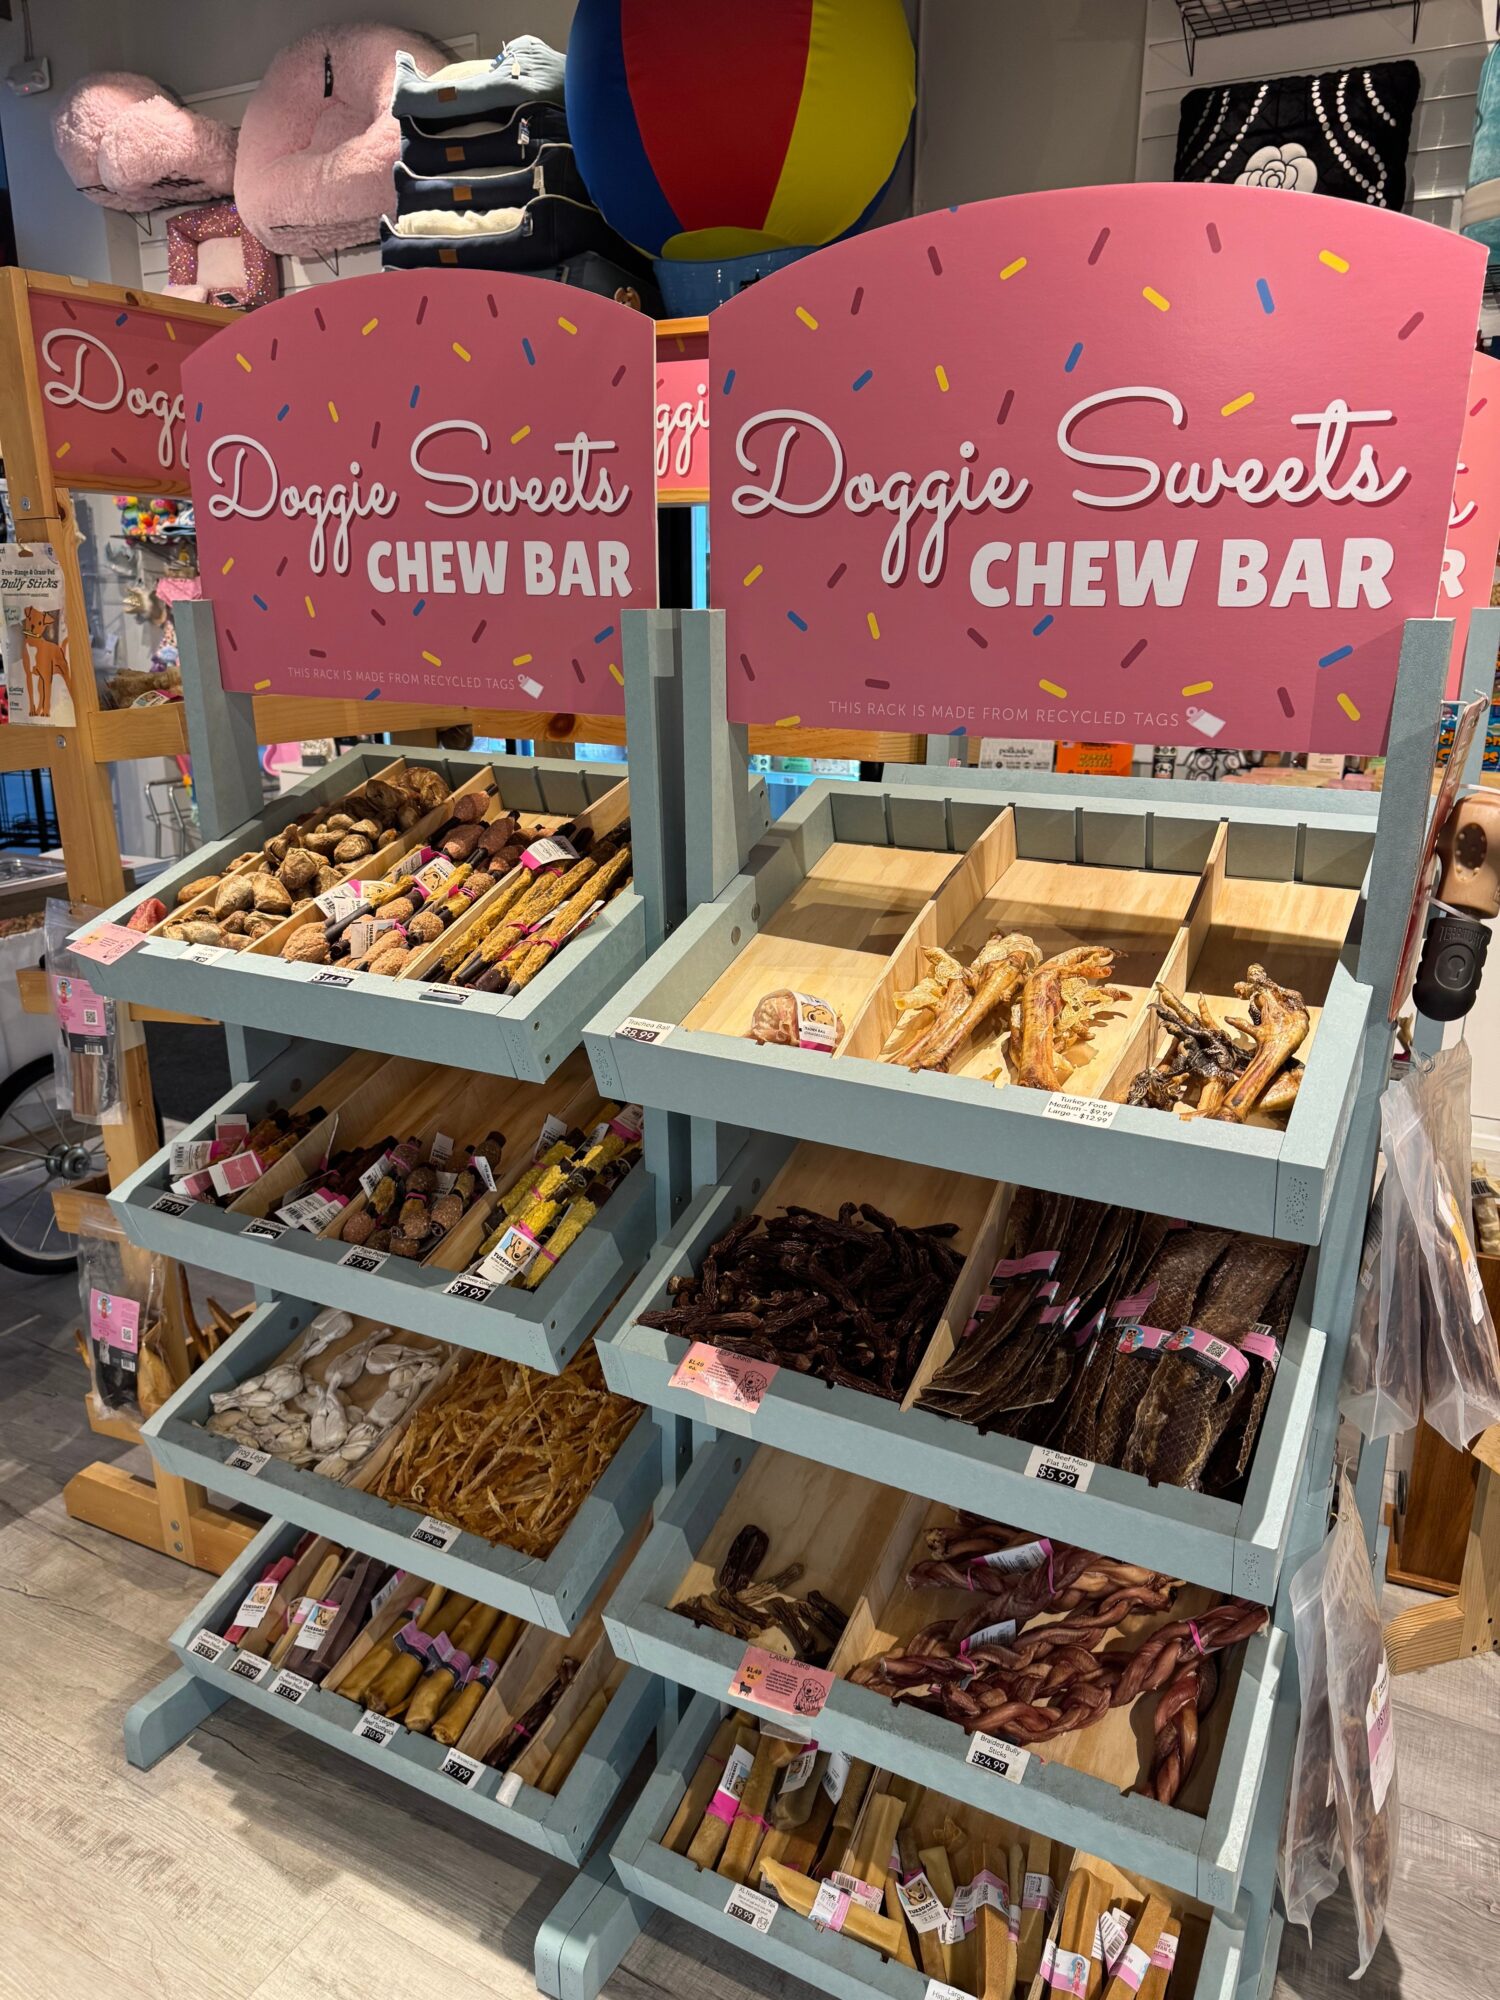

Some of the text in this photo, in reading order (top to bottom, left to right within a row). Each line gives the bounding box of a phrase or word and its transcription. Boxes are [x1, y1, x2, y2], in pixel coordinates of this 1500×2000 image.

[42, 328, 189, 470] Dog
[730, 386, 1409, 587] Doggie Sweets
[207, 418, 632, 575] Doggie Sweets
[366, 539, 634, 600] CHEW BAR
[969, 538, 1199, 609] CHEW
[1216, 536, 1396, 610] BAR
[0, 577, 59, 591] Bully Sticks
[288, 667, 515, 691] THIS RACK IS MADE FROM RECYCLED TAGS
[829, 700, 1180, 727] THIS RACK IS MADE FROM RECYCLED TAGS
[628, 1018, 655, 1029] Trachea
[622, 1027, 655, 1041] $8.99
[1048, 1101, 1082, 1112] Medium
[1089, 1107, 1114, 1117] $9.99
[1061, 1096, 1108, 1110] Turkey Foot
[1047, 1107, 1071, 1117] Large
[1078, 1112, 1108, 1123] $12.99
[155, 1200, 185, 1214] $7.99
[345, 1254, 376, 1270] $7.99
[493, 1252, 519, 1271] TUESDAY'S
[450, 1282, 486, 1300] $7.99
[688, 1358, 705, 1368] $1.49
[732, 1353, 753, 1364] LINKS
[1041, 1448, 1089, 1468] 12" Beef Moo
[1046, 1458, 1079, 1473] Flat Taffy
[1037, 1465, 1076, 1485] $5.99
[414, 1529, 434, 1542] $0.99
[193, 1643, 217, 1659] $13.99
[233, 1660, 259, 1678] $13.99
[746, 1665, 762, 1675] $1.49
[768, 1653, 811, 1671] LAMB LINKS
[275, 1683, 300, 1700] $13.99
[362, 1717, 374, 1725] Beef
[371, 1713, 396, 1728] Full Length
[362, 1726, 385, 1742] $10.99
[980, 1734, 1022, 1757] Braided Bully
[988, 1746, 1007, 1759] Sticks
[444, 1759, 471, 1780] $7.99
[972, 1751, 1007, 1772] $24.99
[727, 1902, 754, 1922] $19.99
[908, 1899, 937, 1914] TUESDAY'S
[947, 1988, 965, 2000] Large
